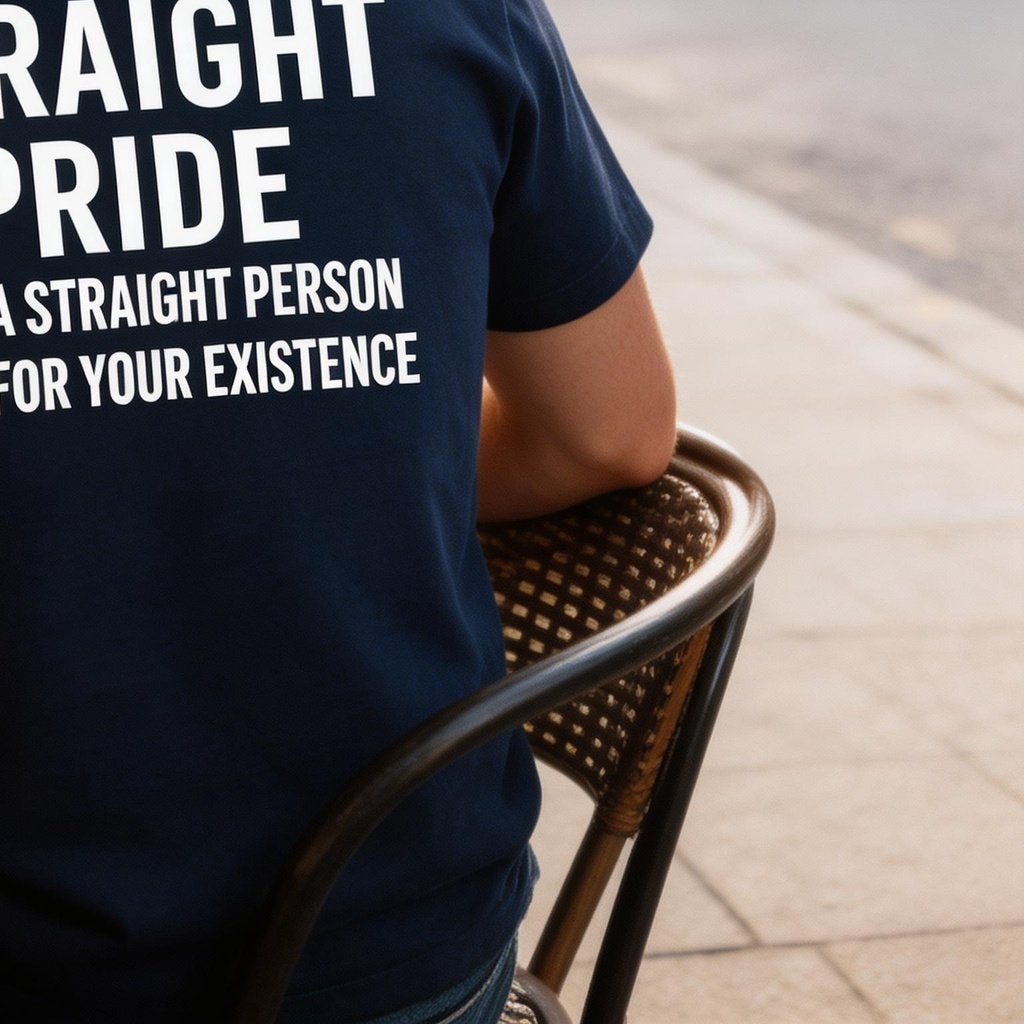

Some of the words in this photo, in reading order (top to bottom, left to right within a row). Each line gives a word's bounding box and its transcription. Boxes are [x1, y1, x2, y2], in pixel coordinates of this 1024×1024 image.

[23, 267, 232, 335] STRAIGHT
[242, 258, 404, 318] PERSON
[78, 347, 193, 407] YOUR
[203, 331, 421, 398] EXISTENCE
